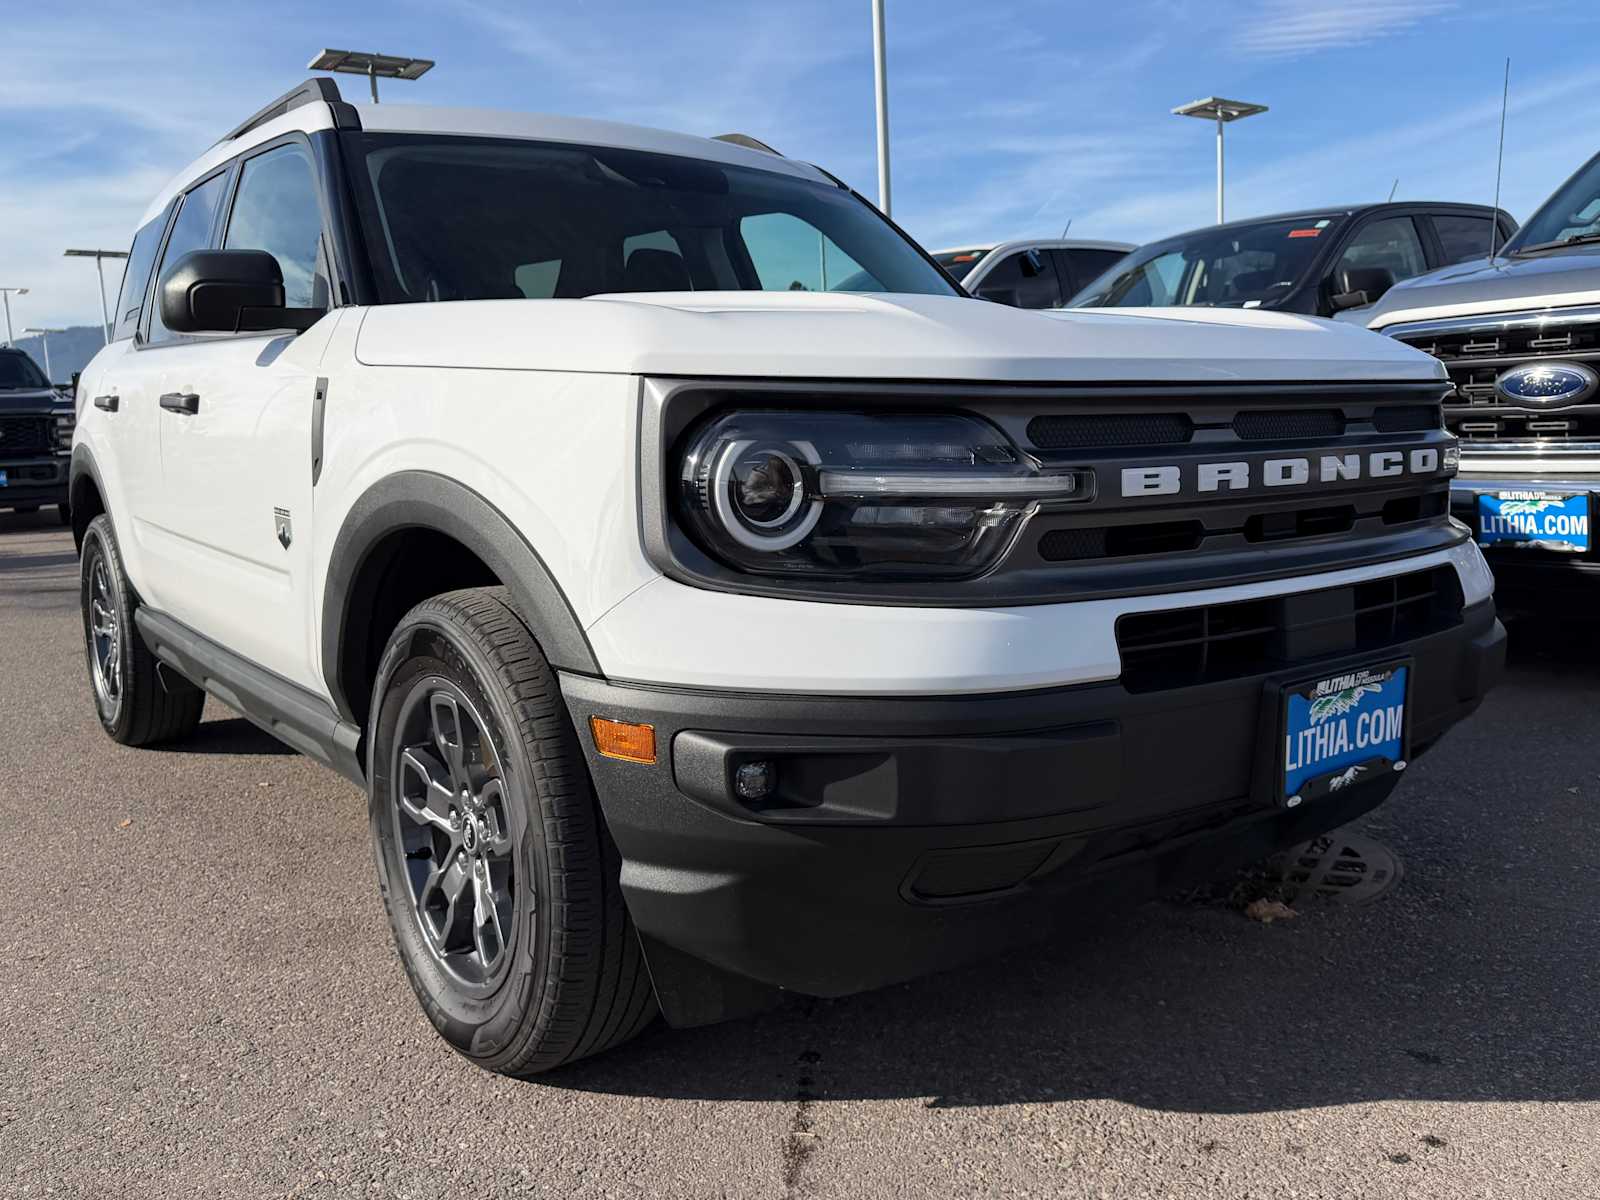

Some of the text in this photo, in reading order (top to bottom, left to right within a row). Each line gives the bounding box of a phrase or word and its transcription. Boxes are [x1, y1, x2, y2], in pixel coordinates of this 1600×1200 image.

[1121, 449, 1438, 497] BRONCO
[1481, 515, 1588, 535] LITHIA.COM
[1325, 673, 1356, 693] LITHIA
[1285, 705, 1404, 771] LITHIA.COM
